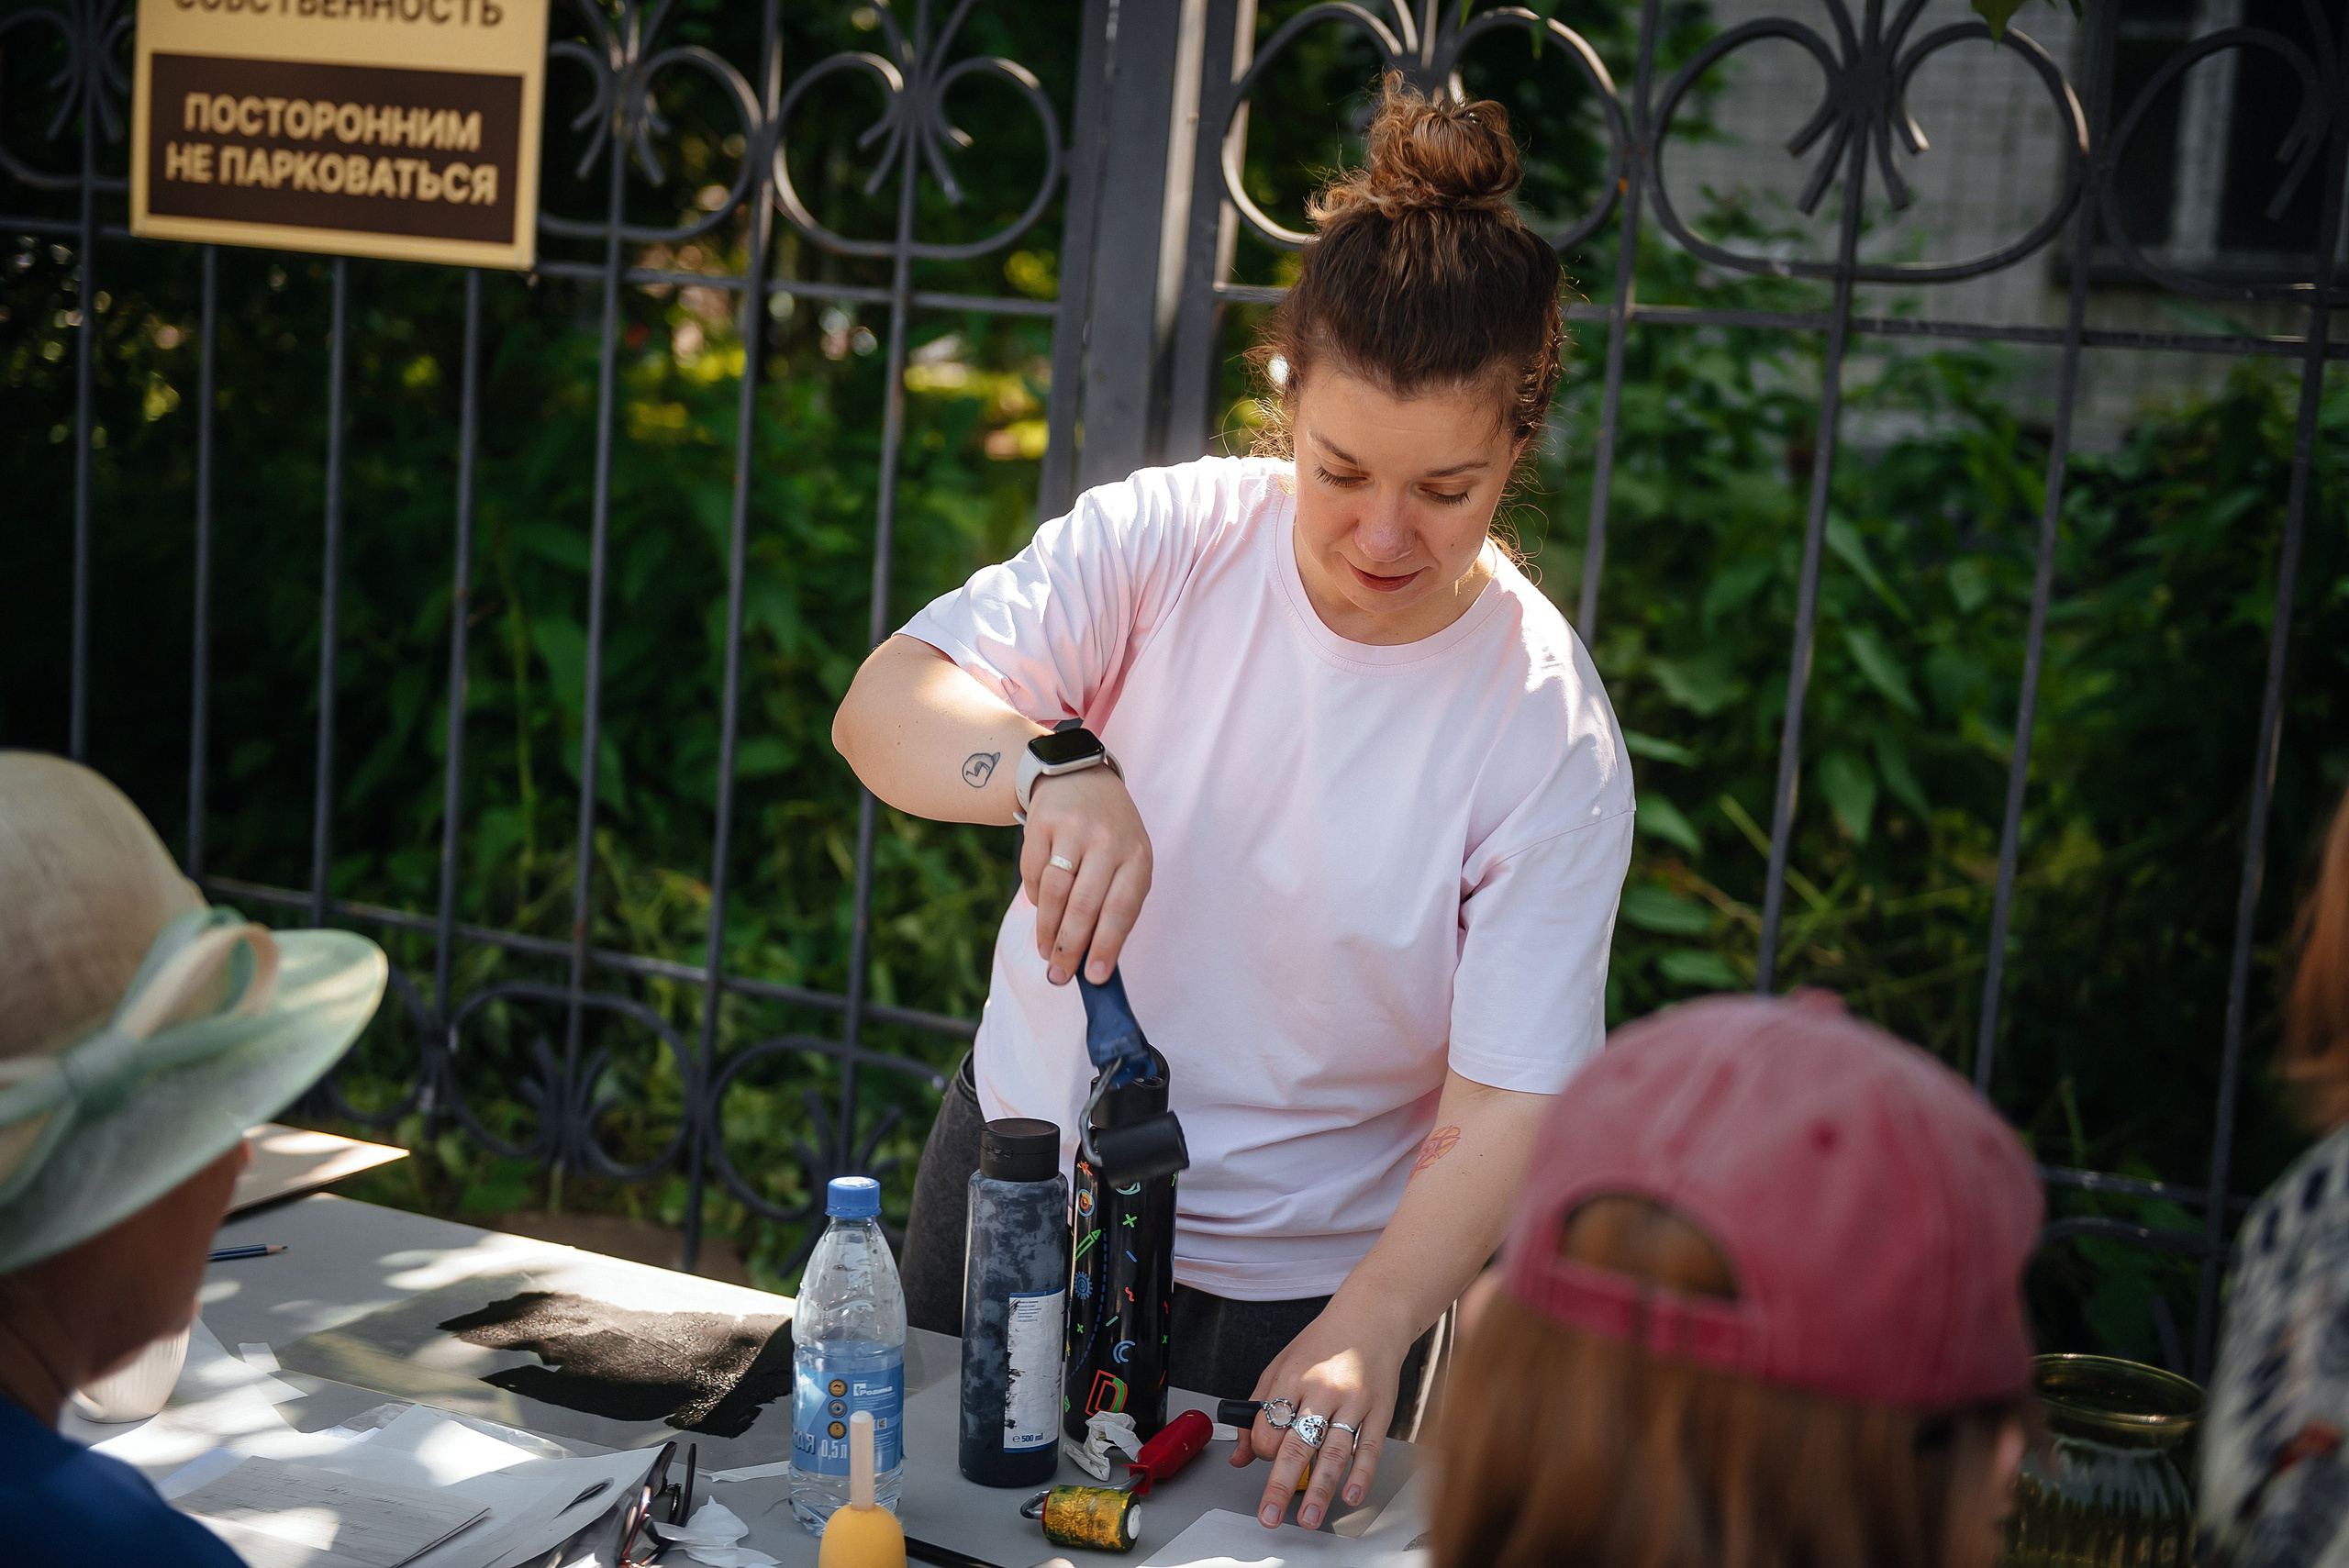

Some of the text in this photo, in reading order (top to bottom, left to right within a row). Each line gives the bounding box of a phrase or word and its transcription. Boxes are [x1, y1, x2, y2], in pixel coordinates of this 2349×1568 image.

[184, 94, 482, 151] ПОСТОРОННИМ
[165, 141, 498, 205] НЕ ПАРКОВАТЬСЯ
[1021, 1434, 1034, 1443] 500
[1034, 1432, 1044, 1441] ml
